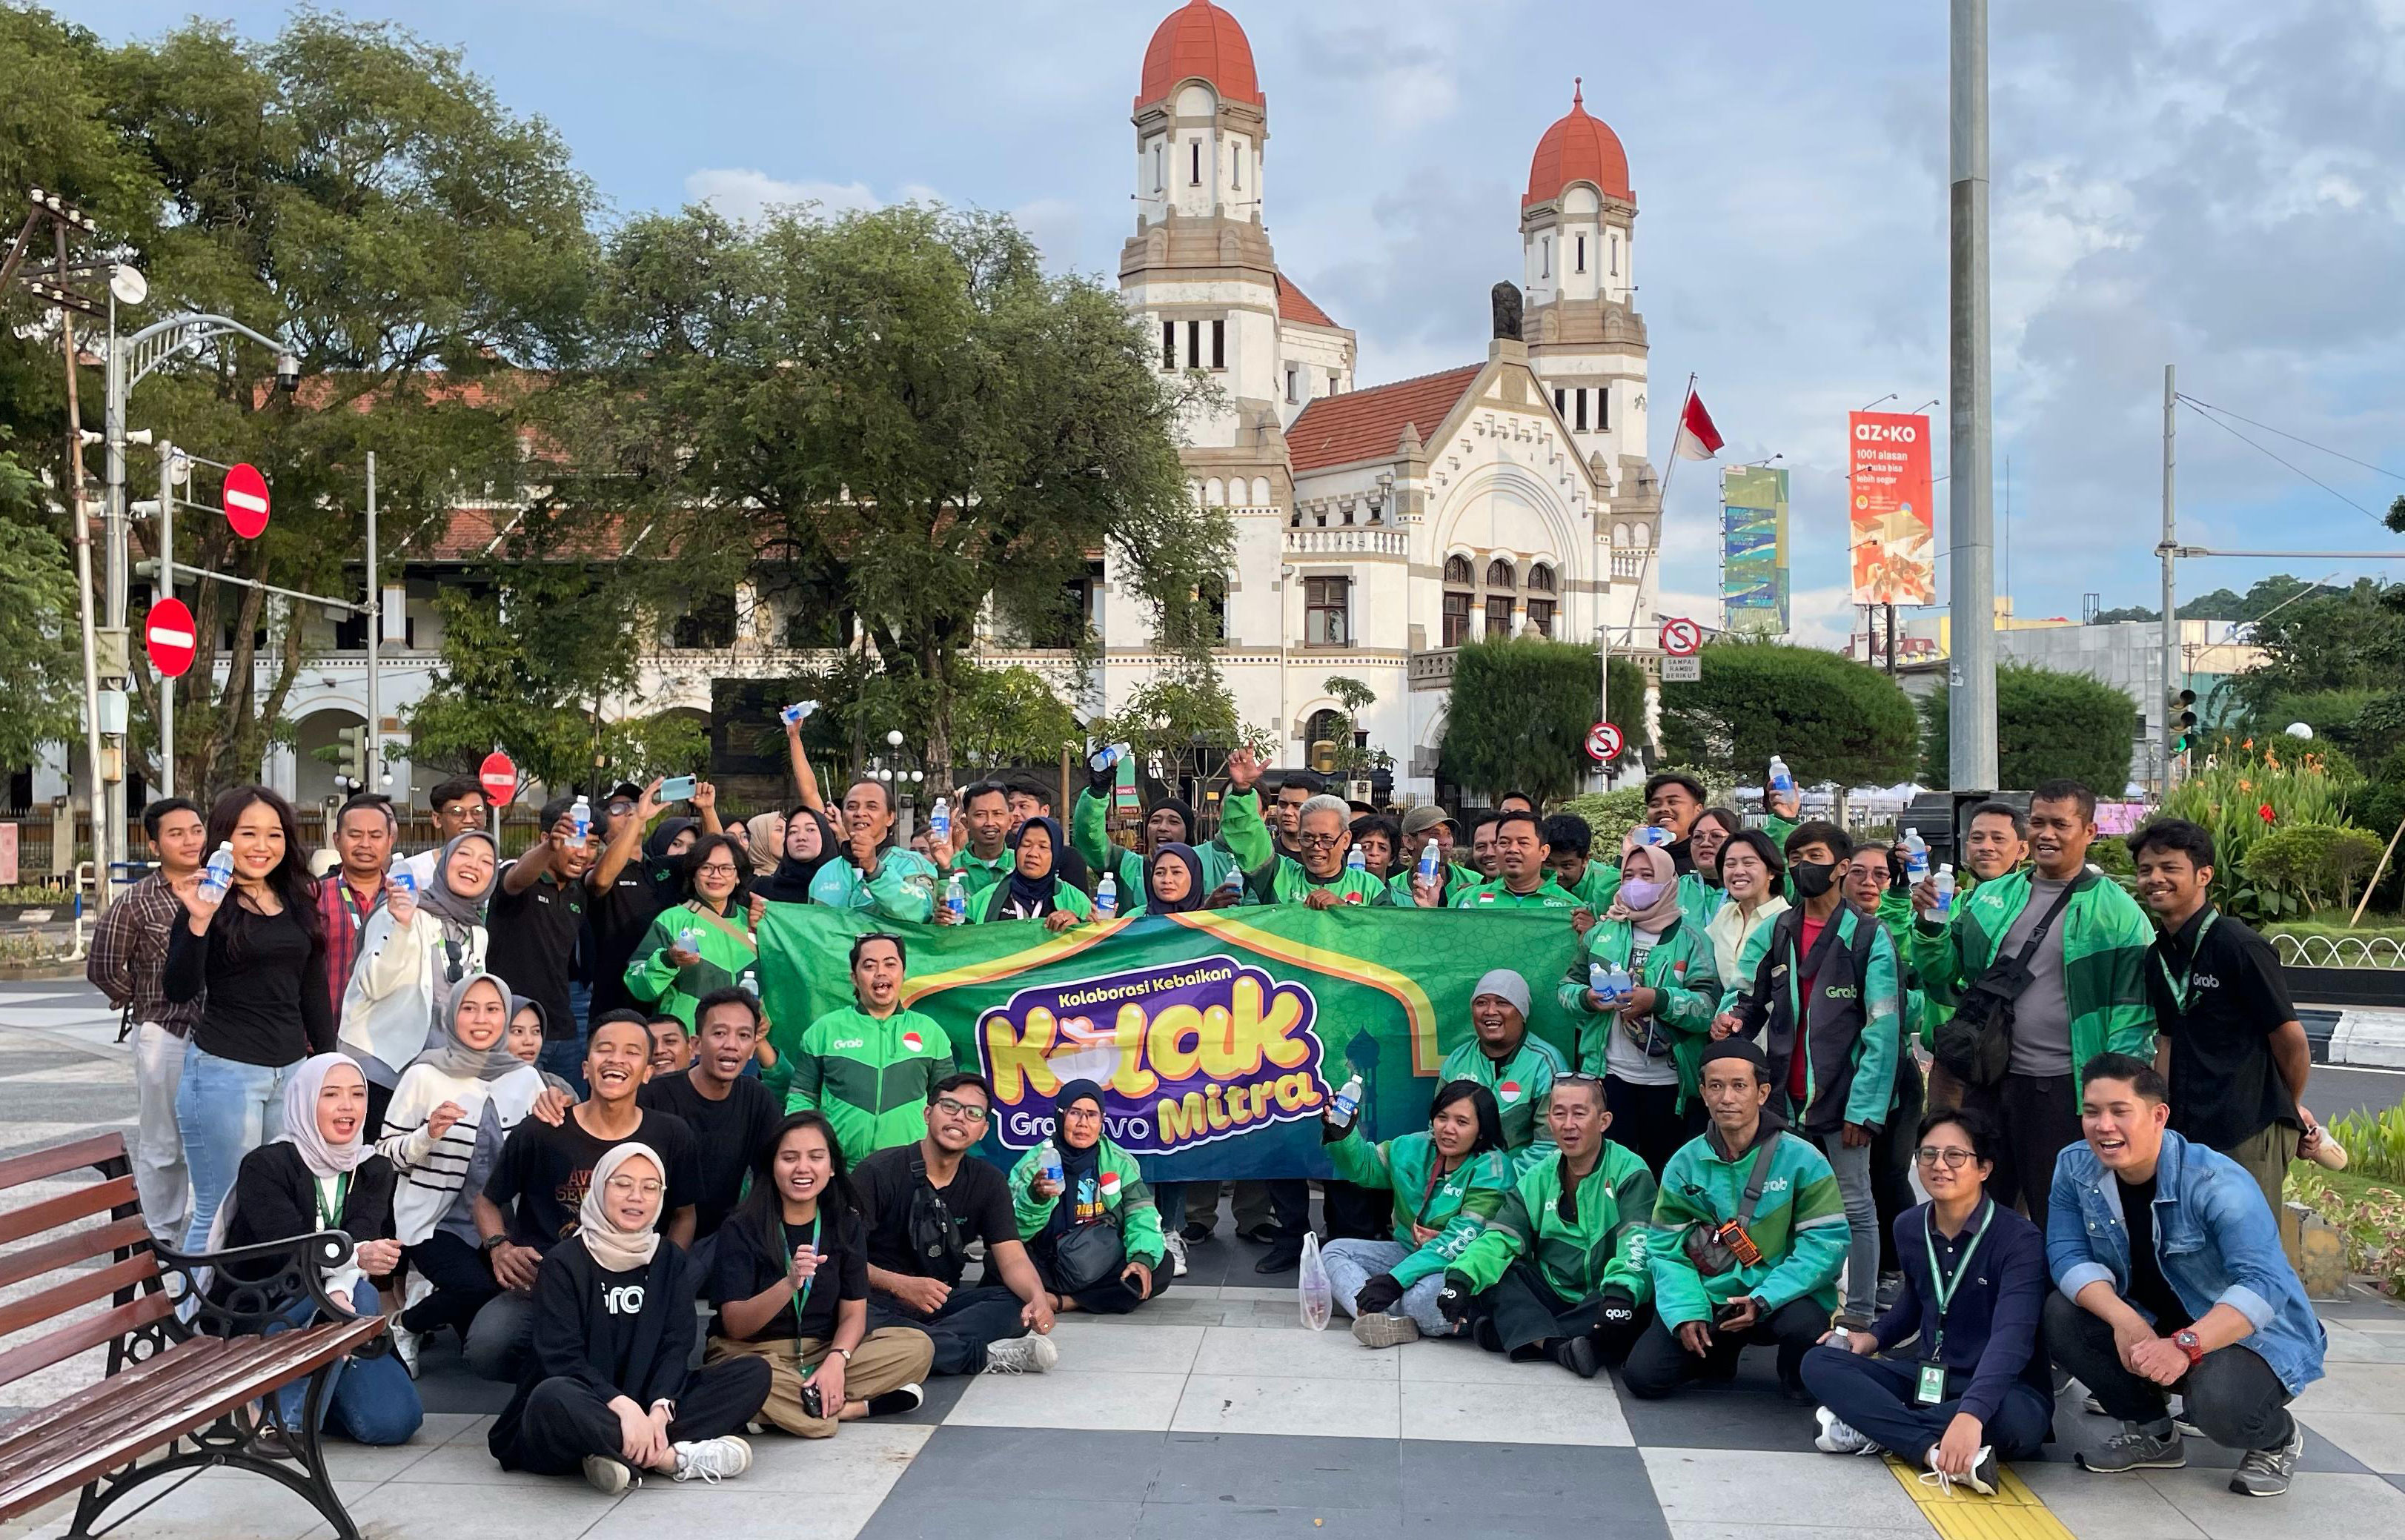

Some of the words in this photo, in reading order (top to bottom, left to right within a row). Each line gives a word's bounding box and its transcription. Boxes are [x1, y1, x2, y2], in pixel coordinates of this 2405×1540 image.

[1857, 449, 1877, 459] 1001
[1878, 451, 1908, 460] alasan
[1058, 980, 1150, 1009] Kolaborasi
[1153, 967, 1233, 992] Kebaikan
[2193, 973, 2219, 988] Grab
[1825, 984, 1857, 998] Grab
[834, 1038, 863, 1050] Grab
[1158, 1072, 1323, 1144] Mitra
[1010, 1112, 1056, 1136] Gra
[1444, 1183, 1464, 1198] Gra
[1605, 1309, 1632, 1320] Grab
